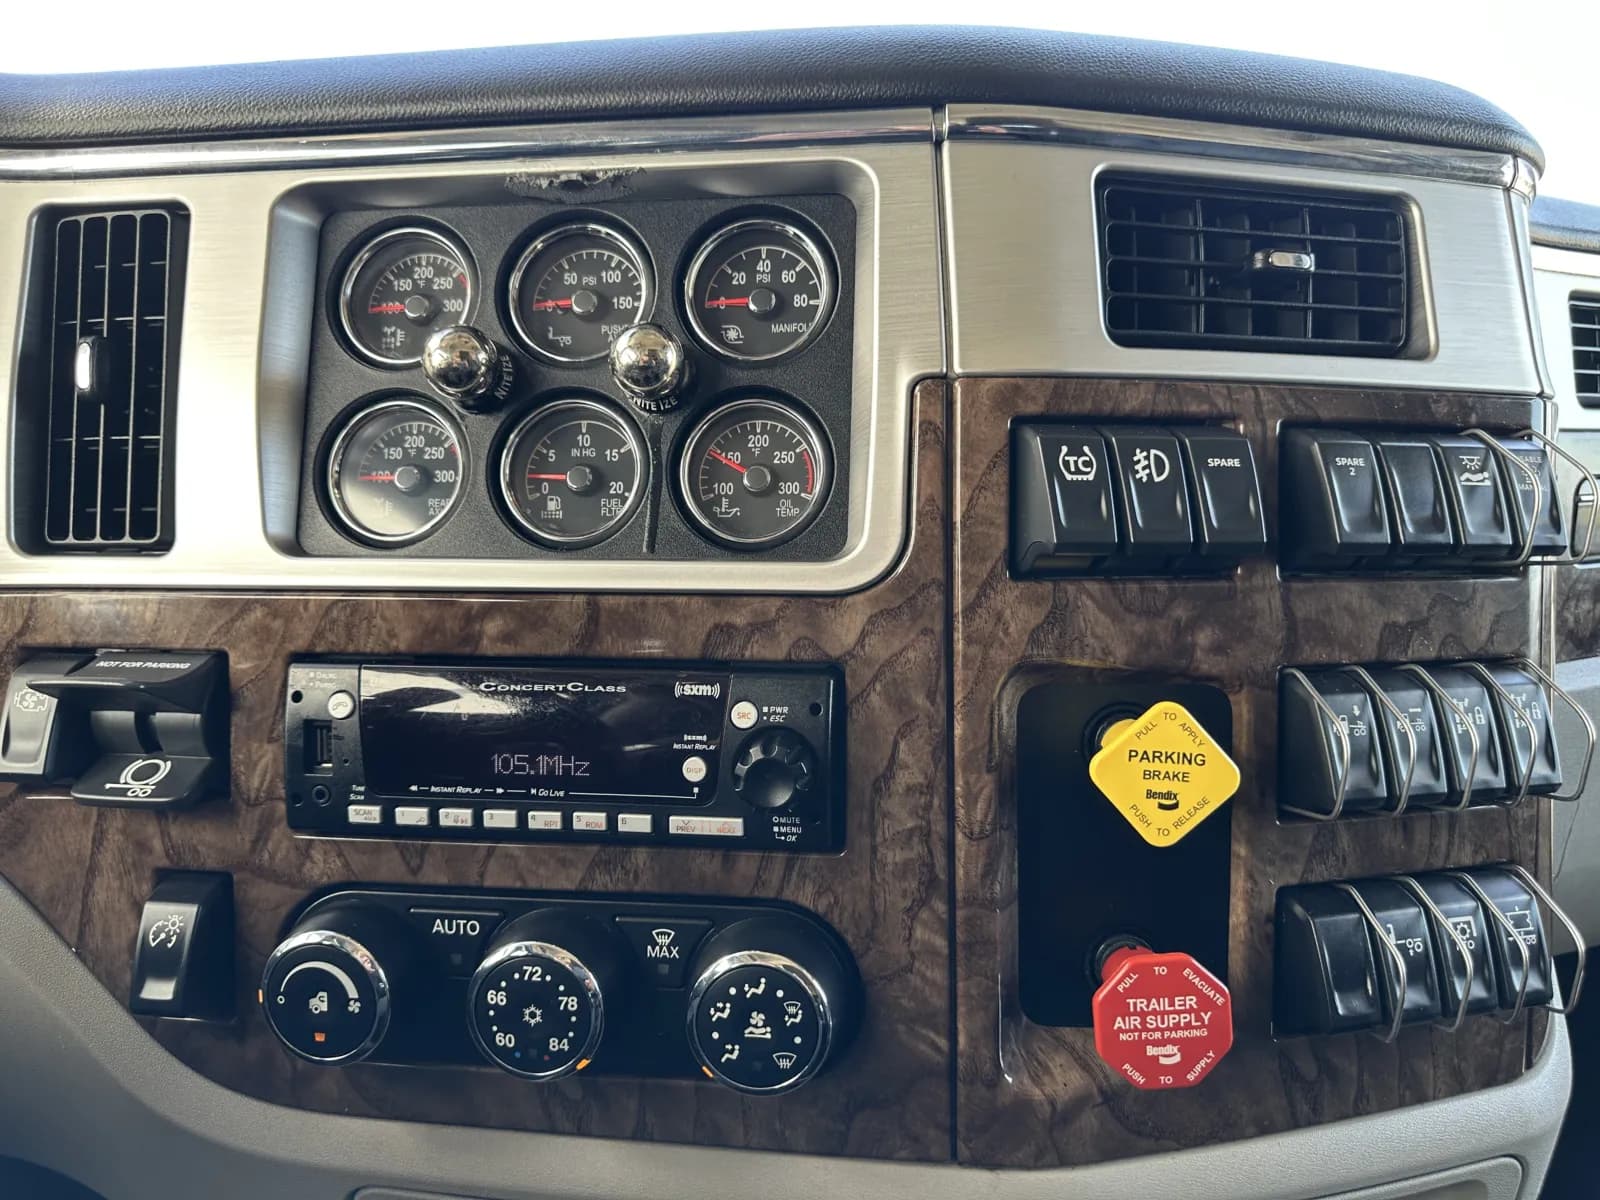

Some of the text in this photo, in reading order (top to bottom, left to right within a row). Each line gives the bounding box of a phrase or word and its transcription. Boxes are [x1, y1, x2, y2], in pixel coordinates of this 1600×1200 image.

[756, 260, 771, 272] 40
[414, 267, 434, 279] 200
[564, 273, 578, 285] 50
[601, 271, 622, 283] 100
[732, 272, 746, 285] 20
[756, 274, 771, 284] PSI
[782, 270, 796, 283] 60
[394, 280, 412, 291] 150
[433, 278, 453, 290] 250
[582, 276, 597, 286] PSI
[443, 300, 464, 312] 300
[613, 296, 632, 310] 150
[794, 294, 808, 308] 80
[771, 322, 814, 334] MANIFOL
[658, 396, 678, 411] IZE
[404, 436, 424, 448] 200
[577, 434, 590, 447] 10
[748, 434, 769, 448] 200
[384, 448, 402, 460] 150
[424, 448, 444, 460] 250
[548, 450, 556, 462] 5
[572, 448, 596, 458] IN HG
[605, 449, 619, 462] 15
[722, 452, 741, 464] 150
[774, 452, 794, 464] 250
[1064, 456, 1092, 472] TC
[1207, 458, 1240, 468] SPARE
[1336, 457, 1366, 468] SPARE
[434, 470, 455, 482] 300
[1348, 467, 1356, 476] 2
[542, 482, 548, 494] 0
[609, 482, 624, 494] 20
[713, 482, 734, 495] 100
[778, 482, 800, 494] 300
[601, 498, 624, 508] FUEL
[780, 499, 793, 508] OIL
[776, 508, 800, 518] TEMP
[142, 662, 192, 670] PARKING
[736, 712, 752, 720] SRC
[1135, 712, 1205, 748] PULL TO APPLY
[1128, 749, 1206, 767] PARKING
[491, 754, 590, 776] 105.1MHz
[1142, 770, 1190, 783] BRAKE
[1146, 788, 1178, 801] Bendix
[353, 808, 373, 816] SCAN
[1130, 796, 1210, 836] PUSH TO RELEASE
[432, 918, 480, 936] AUTO
[646, 946, 680, 959] MAX
[522, 966, 542, 982] 72
[1116, 966, 1226, 1006] PULL TO EVACUATE
[487, 990, 507, 1006] 66
[558, 996, 578, 1011] 78
[1126, 996, 1198, 1012] TRAILER
[1113, 1012, 1212, 1030] AIR SUPPLY
[495, 1032, 515, 1048] 60
[1120, 1028, 1208, 1041] NOT FOR PARKING
[549, 1038, 570, 1051] 84
[1146, 1044, 1180, 1056] Bendix
[1122, 1050, 1216, 1085] PUSH TO SUPPLY
